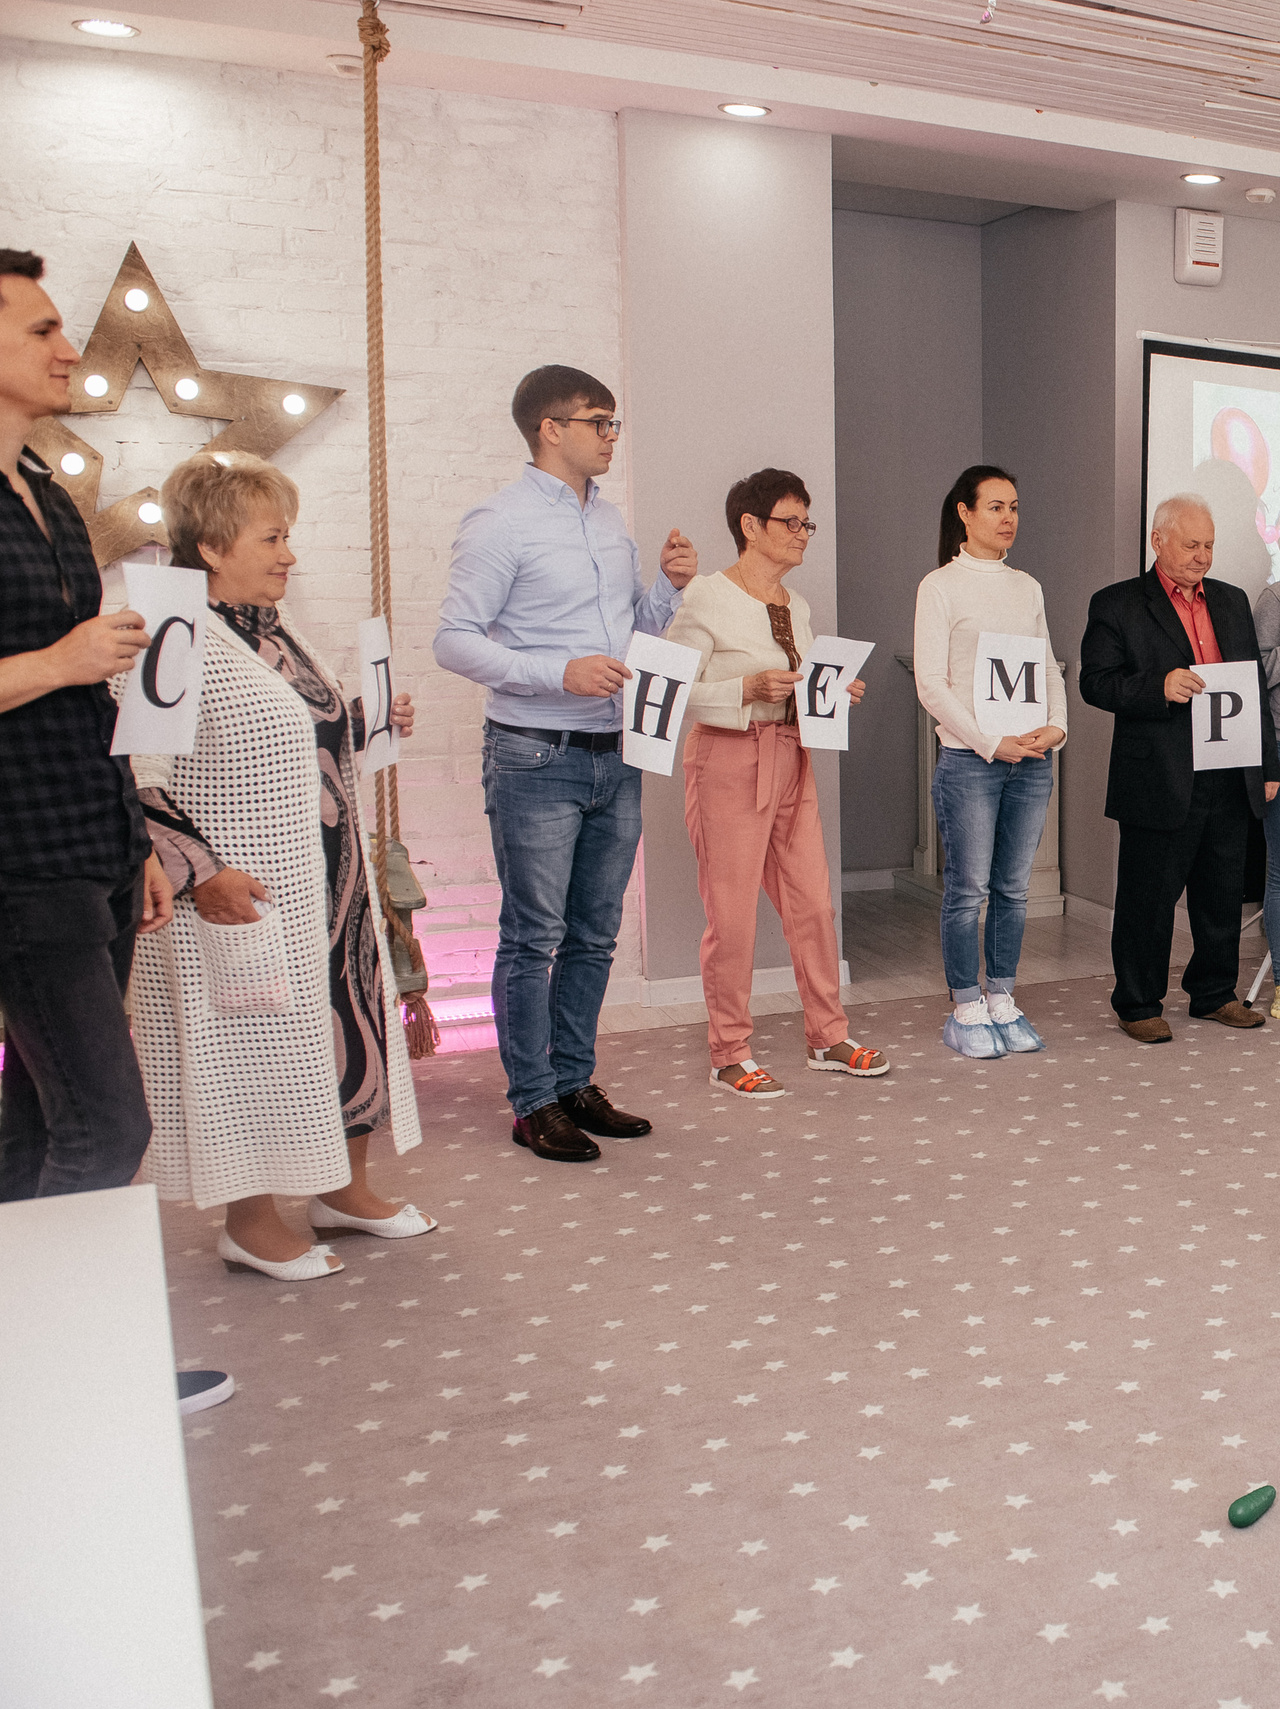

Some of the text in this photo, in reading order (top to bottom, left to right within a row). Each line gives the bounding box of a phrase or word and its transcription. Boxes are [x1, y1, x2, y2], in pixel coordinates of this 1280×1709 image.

[142, 617, 195, 708] С
[805, 661, 845, 719] Е
[985, 657, 1041, 704] М
[367, 656, 393, 749] Д
[632, 668, 687, 735] Н
[1204, 691, 1243, 743] Р
